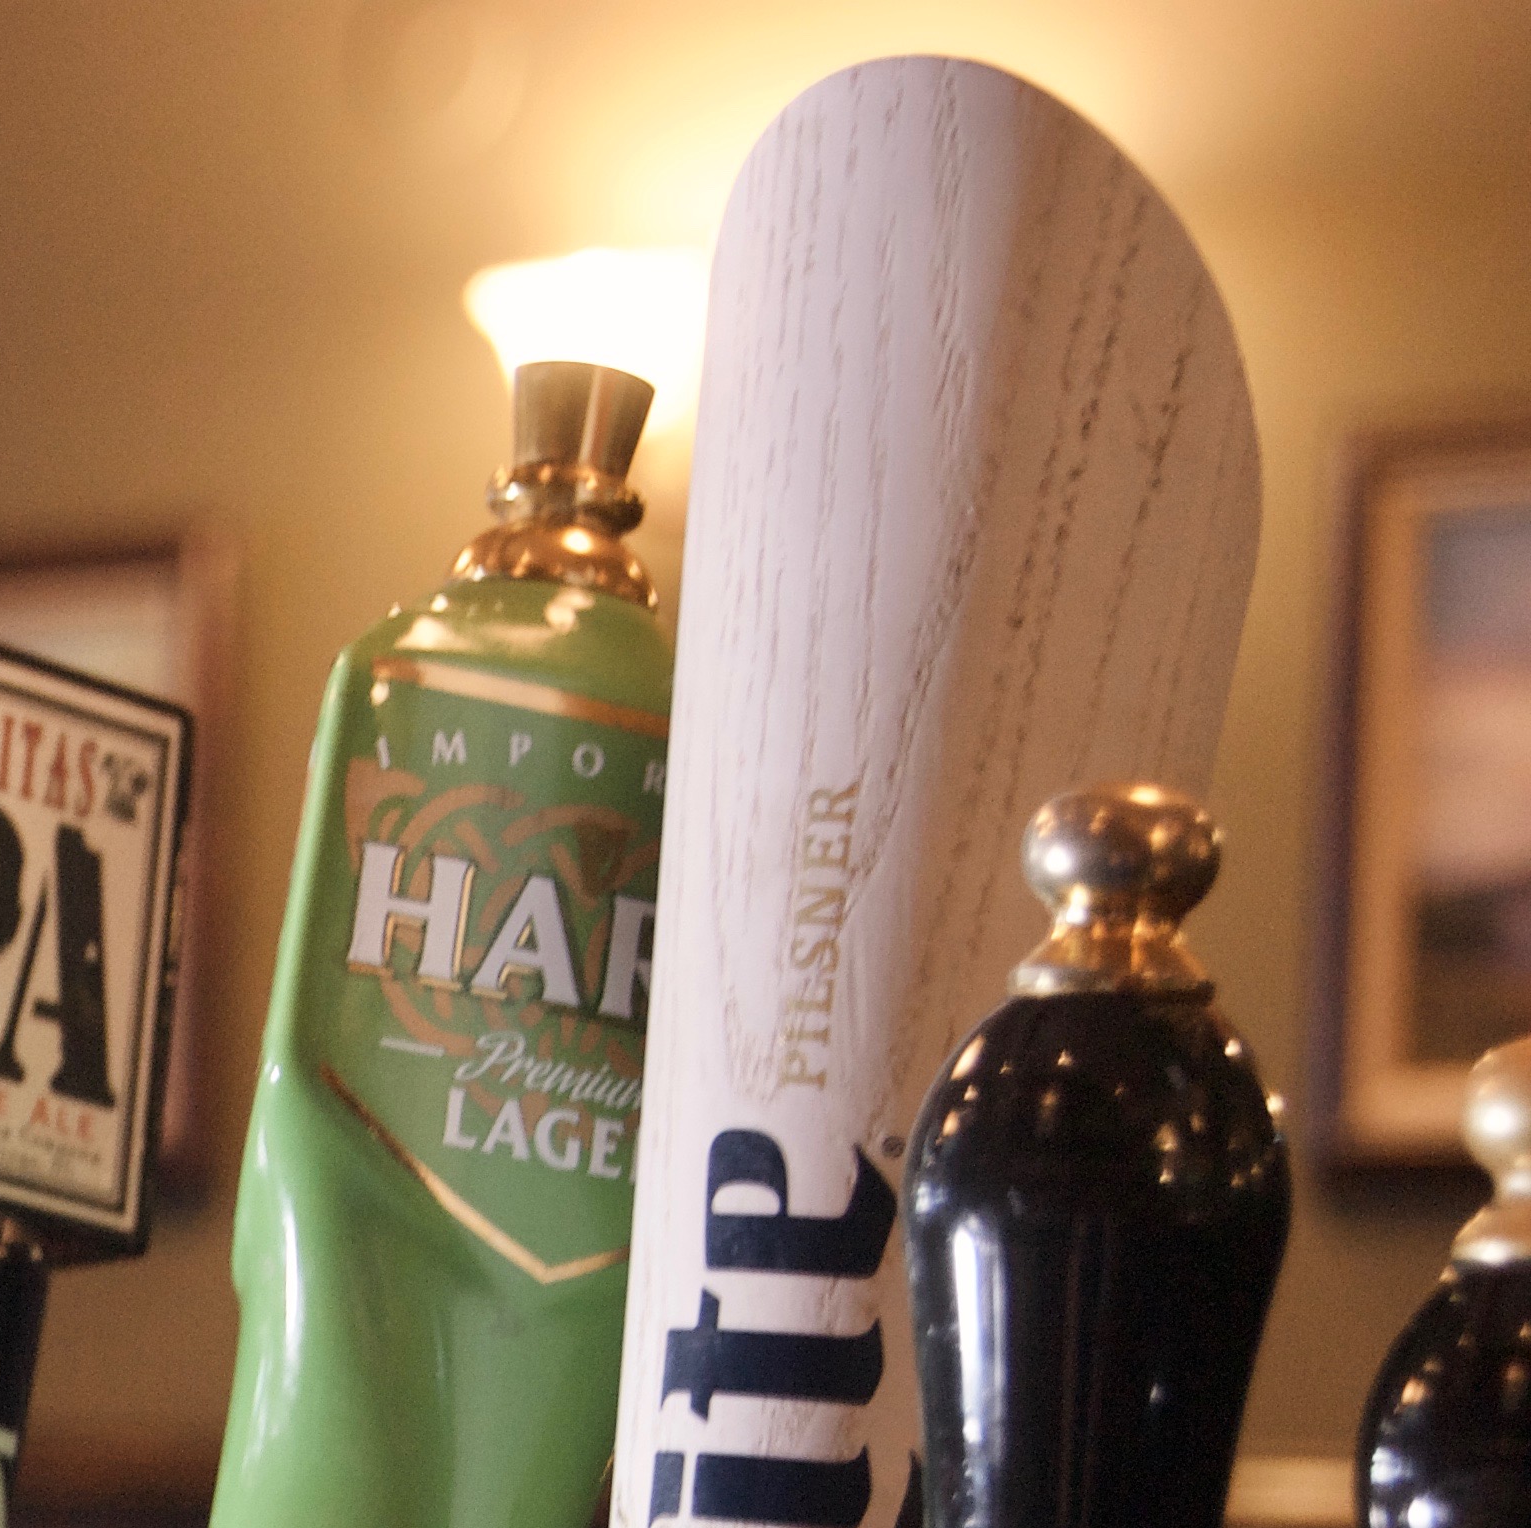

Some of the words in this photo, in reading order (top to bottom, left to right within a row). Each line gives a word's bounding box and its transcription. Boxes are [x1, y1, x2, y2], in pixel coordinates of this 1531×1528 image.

[374, 729, 666, 797] IMPOR
[347, 838, 655, 1025] HAR
[779, 781, 860, 1092] PILSNER
[28, 1096, 94, 1143] ALE
[442, 1086, 638, 1185] LAGE
